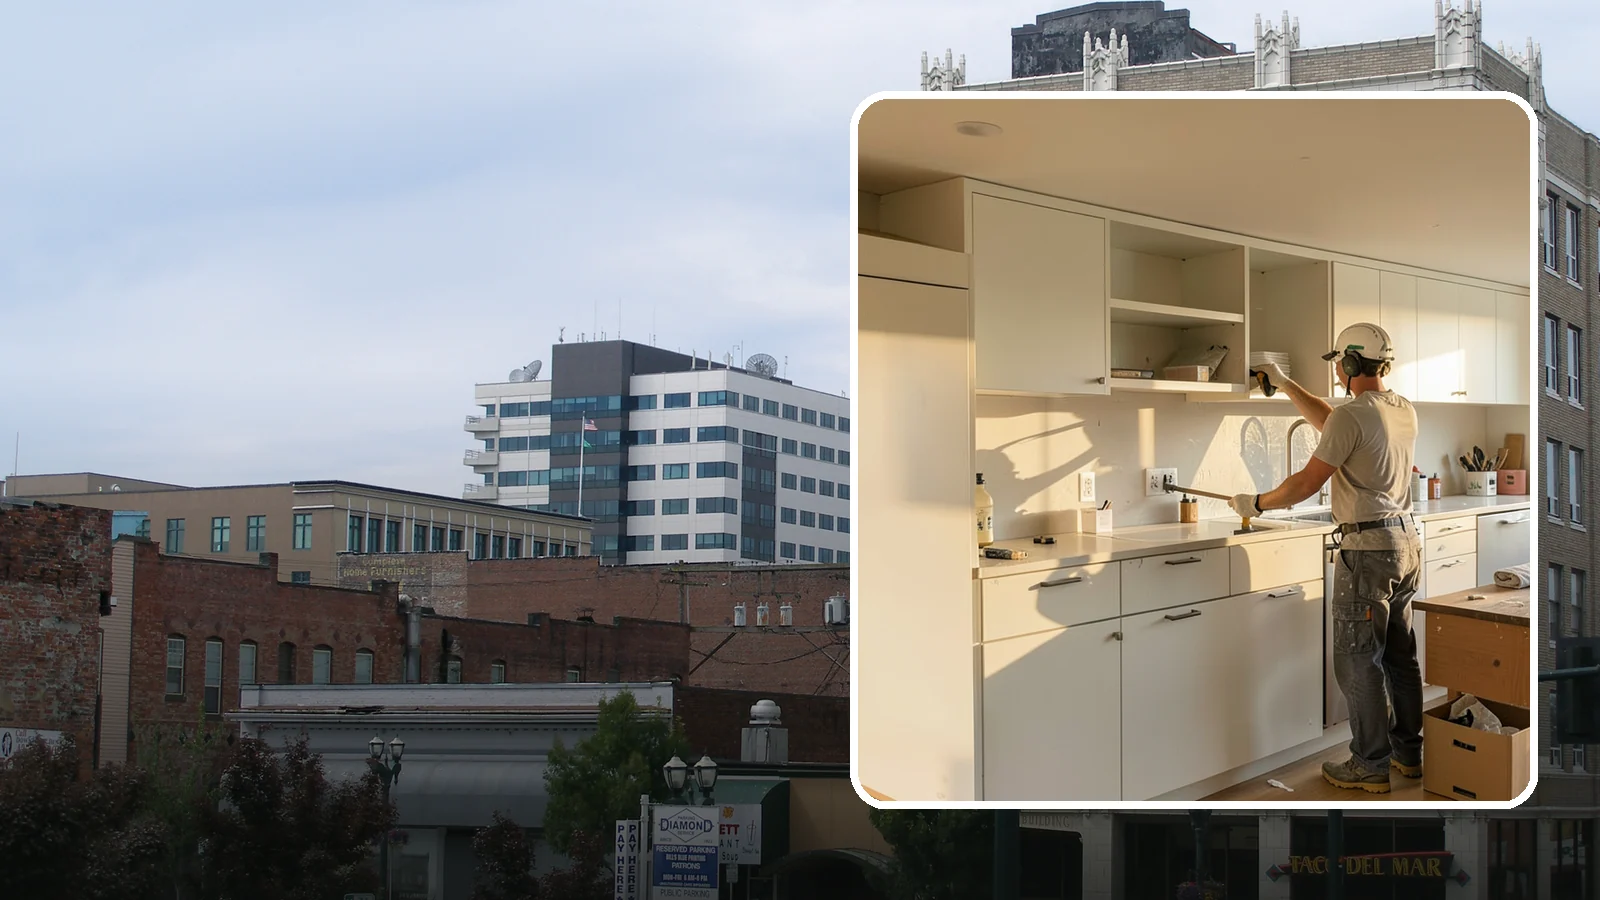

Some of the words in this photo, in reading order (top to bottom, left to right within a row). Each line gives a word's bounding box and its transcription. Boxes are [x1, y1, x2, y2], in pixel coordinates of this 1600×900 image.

[370, 566, 427, 576] Furnishers
[660, 818, 713, 833] DIAMOND
[1021, 815, 1070, 828] BUILDING
[617, 825, 625, 852] PAY
[628, 825, 637, 852] PAY
[721, 852, 739, 862] Soup
[671, 862, 701, 870] PATRONS
[1288, 855, 1330, 874] TAC
[1345, 856, 1384, 875] DEL
[1392, 857, 1443, 877] MAR
[616, 856, 625, 893] HERE
[627, 856, 636, 893] HERE
[660, 888, 682, 897] PUBLIC
[683, 889, 710, 898] PARKING
